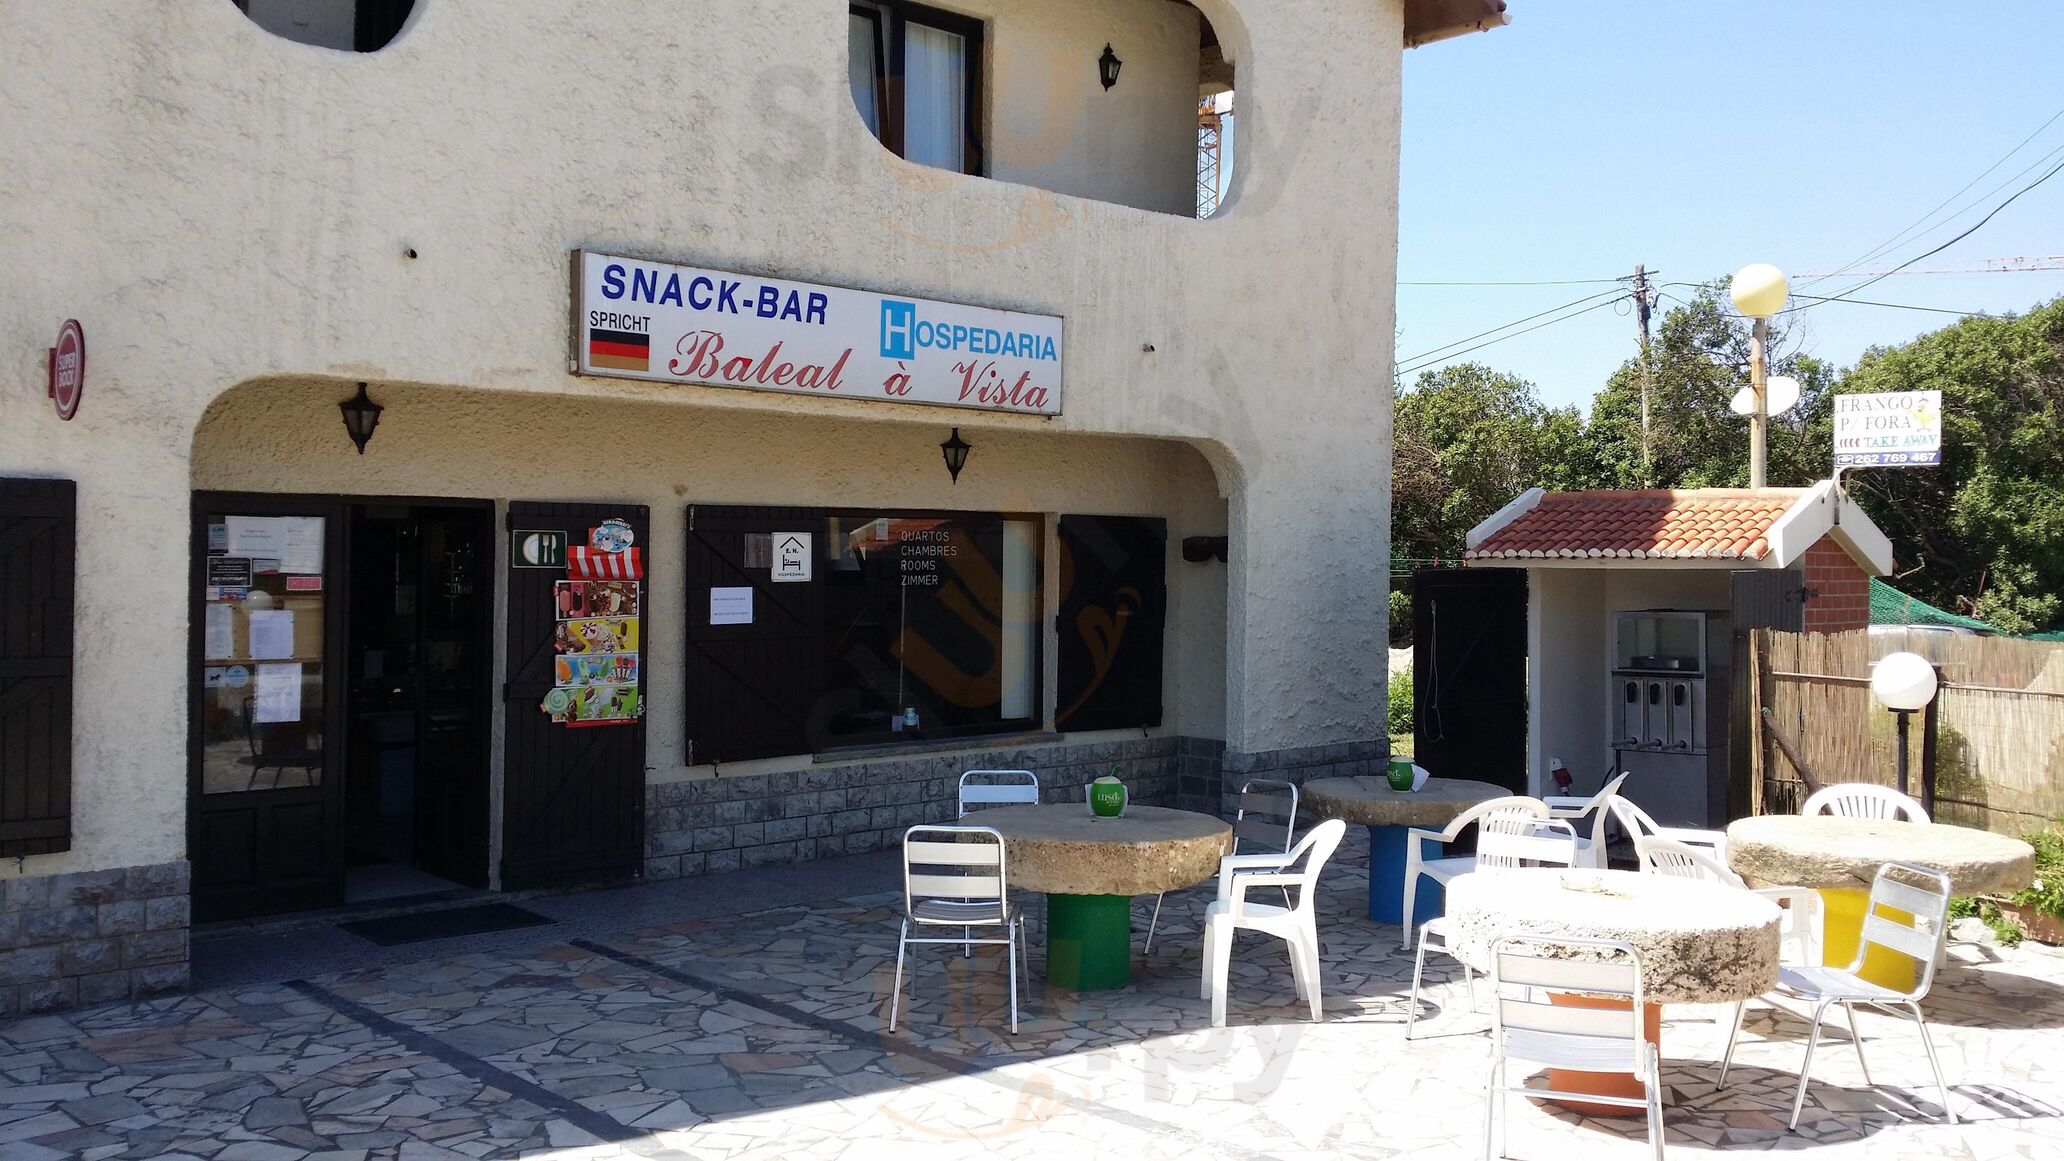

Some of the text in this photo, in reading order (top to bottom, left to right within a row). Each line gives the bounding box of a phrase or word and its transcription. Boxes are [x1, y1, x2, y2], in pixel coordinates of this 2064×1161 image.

[601, 264, 828, 325] SNACK-BAR
[589, 310, 651, 332] SPRICHT
[881, 302, 1058, 362] HOSPEDARIA
[58, 353, 75, 370] SUPER
[668, 330, 1049, 408] Baleal à Vista
[1840, 396, 1913, 412] FRANGO
[1865, 415, 1911, 430] FORA
[1864, 434, 1937, 448] TAKE AWAY
[1856, 452, 1936, 464] 262 769 467
[901, 530, 950, 542] QUARTOS
[901, 545, 957, 556] CHAMBRES
[900, 560, 936, 571] ROOMS
[901, 574, 939, 586] ZIMMER
